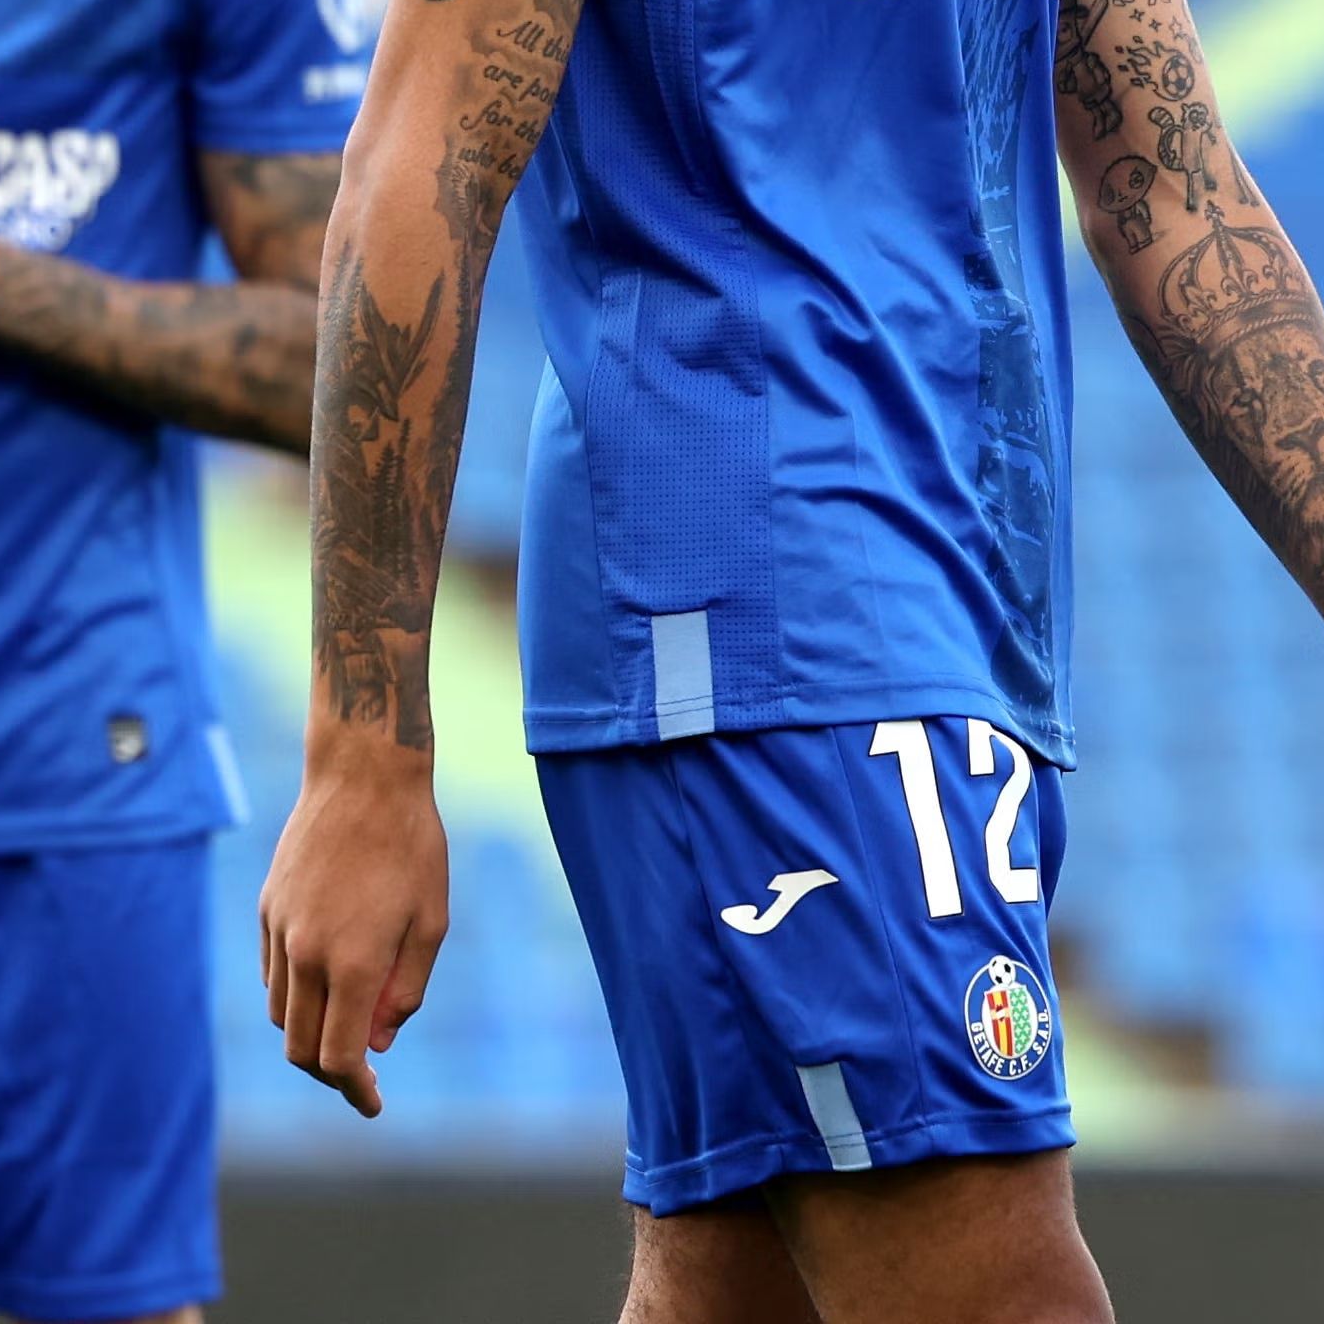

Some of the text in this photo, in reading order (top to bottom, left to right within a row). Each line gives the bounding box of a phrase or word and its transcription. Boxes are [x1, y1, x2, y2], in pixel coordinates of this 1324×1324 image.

[496, 20, 545, 53] All
[483, 63, 524, 89] are
[459, 98, 514, 131] for
[868, 717, 1041, 920] 12
[969, 1007, 1050, 1076] GETAFE C.F. S.A.D.
